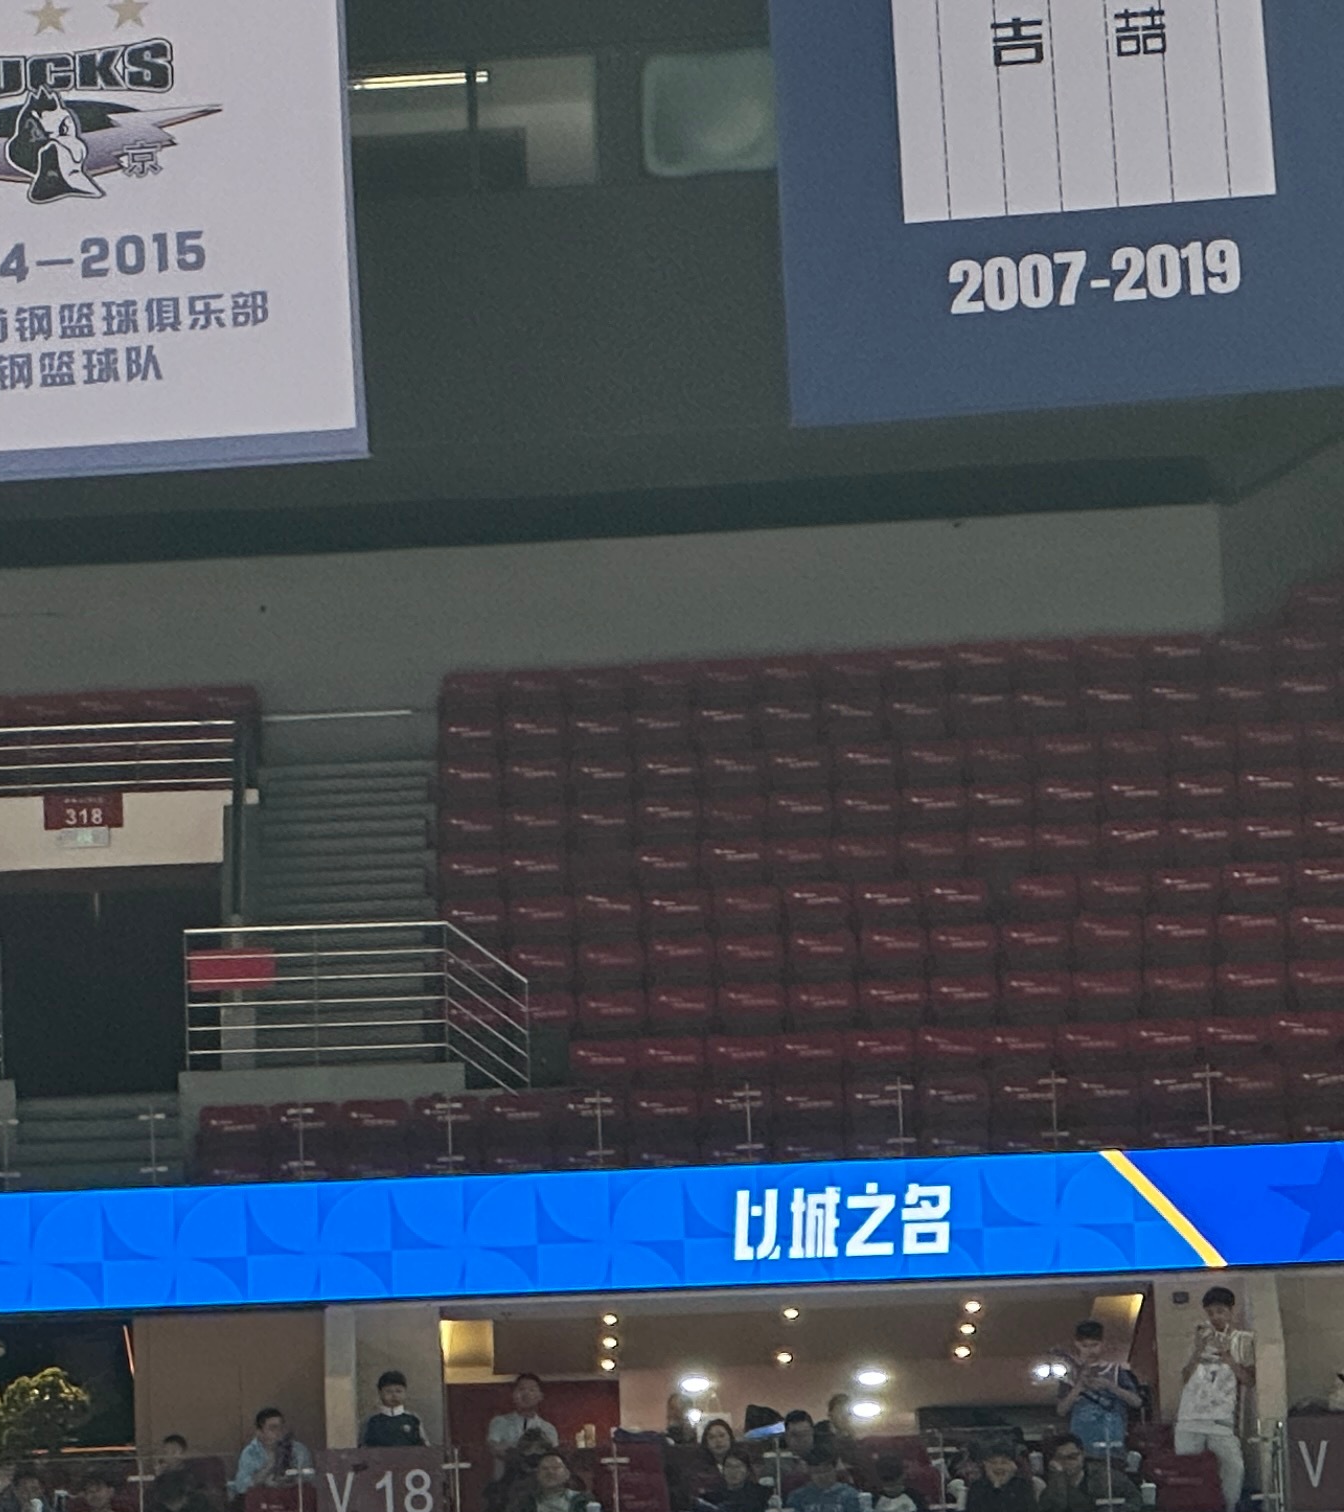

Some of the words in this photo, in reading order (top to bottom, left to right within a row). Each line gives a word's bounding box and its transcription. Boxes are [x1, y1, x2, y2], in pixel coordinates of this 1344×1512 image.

[991, 17, 1043, 67] 吉
[123, 141, 162, 177] 京
[948, 239, 1240, 314] 2007-2019
[65, 807, 103, 825] 318
[733, 1182, 951, 1261] 以城之名
[1298, 1440, 1328, 1488] V
